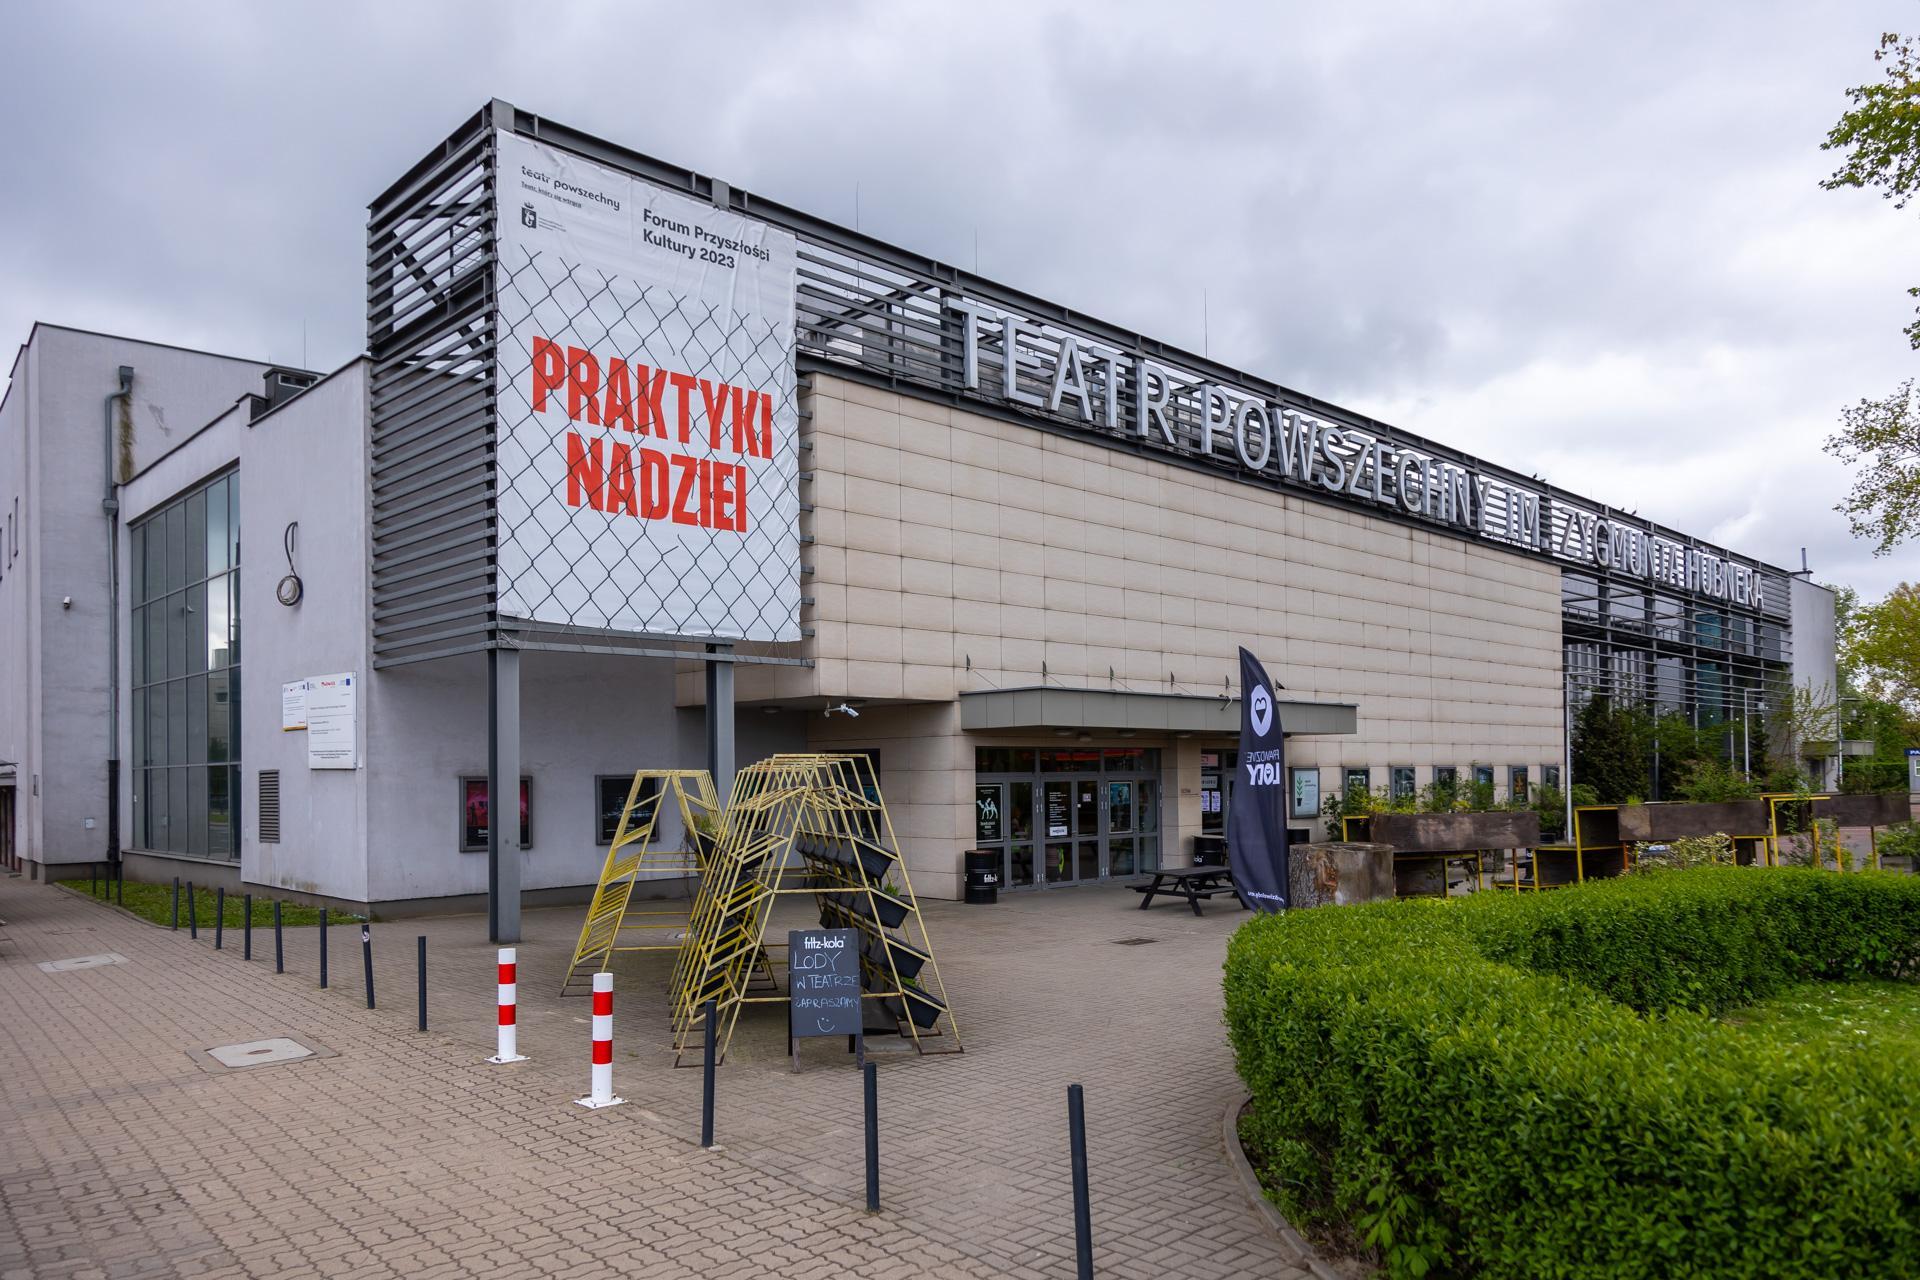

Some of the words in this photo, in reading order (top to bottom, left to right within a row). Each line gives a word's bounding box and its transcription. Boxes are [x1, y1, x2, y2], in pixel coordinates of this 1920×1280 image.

[521, 165, 551, 184] teatr
[553, 180, 620, 212] powszechny
[643, 208, 690, 237] Forum
[694, 226, 771, 263] Przyszłości
[643, 228, 697, 260] Kultury
[700, 248, 736, 270] 2023
[532, 335, 773, 460] PRAKTYKI
[943, 296, 1177, 445] TEATR
[1200, 384, 1493, 532] POWSZECHNY
[1560, 507, 1682, 588] ZYGMUNTA
[1685, 545, 1765, 610] HÜBNERA
[567, 432, 747, 533] NADZIEI
[794, 951, 841, 972] LODY
[804, 936, 844, 949] fritz-kola
